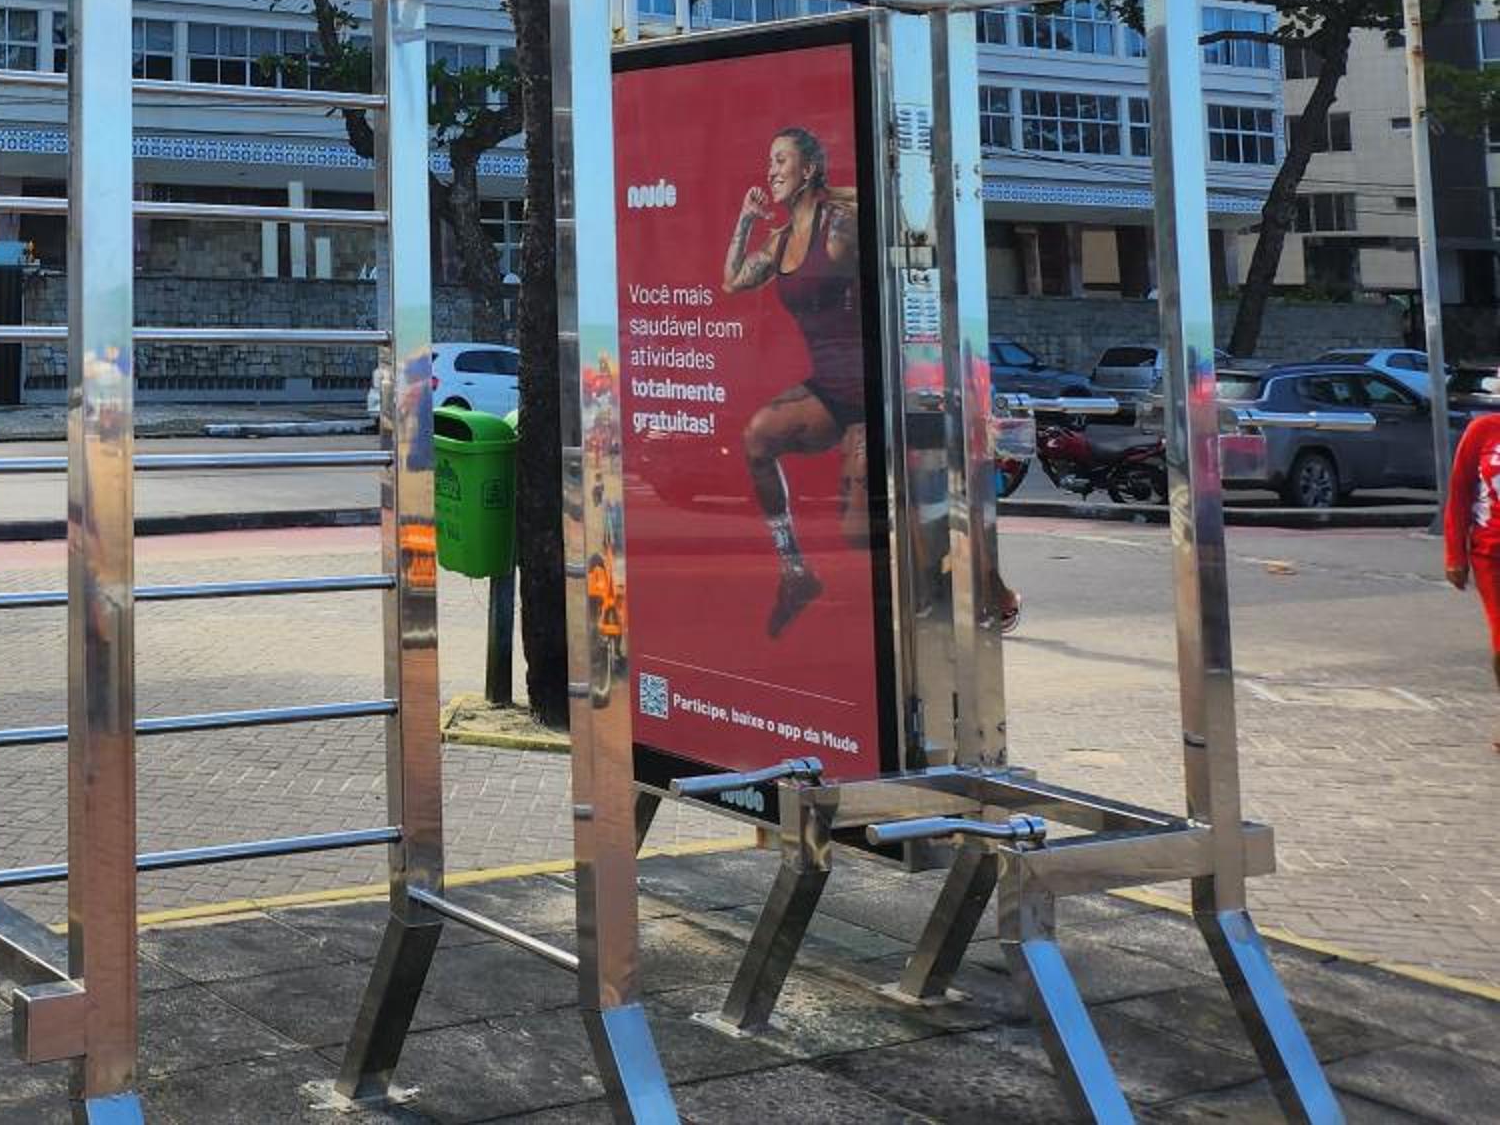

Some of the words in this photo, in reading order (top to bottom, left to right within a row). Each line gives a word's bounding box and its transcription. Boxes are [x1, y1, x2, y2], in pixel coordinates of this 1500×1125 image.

[628, 284, 670, 305] Você
[673, 283, 714, 306] mais
[629, 315, 701, 337] saudável
[705, 321, 744, 339] com
[631, 346, 716, 371] atividades
[631, 376, 726, 403] totalmente
[633, 410, 716, 435] gratuitas!
[672, 693, 730, 723] Participe,
[731, 708, 766, 730] baixe
[766, 719, 776, 733] o
[777, 723, 801, 741] app
[803, 727, 821, 744] da
[822, 730, 860, 754] Mude
